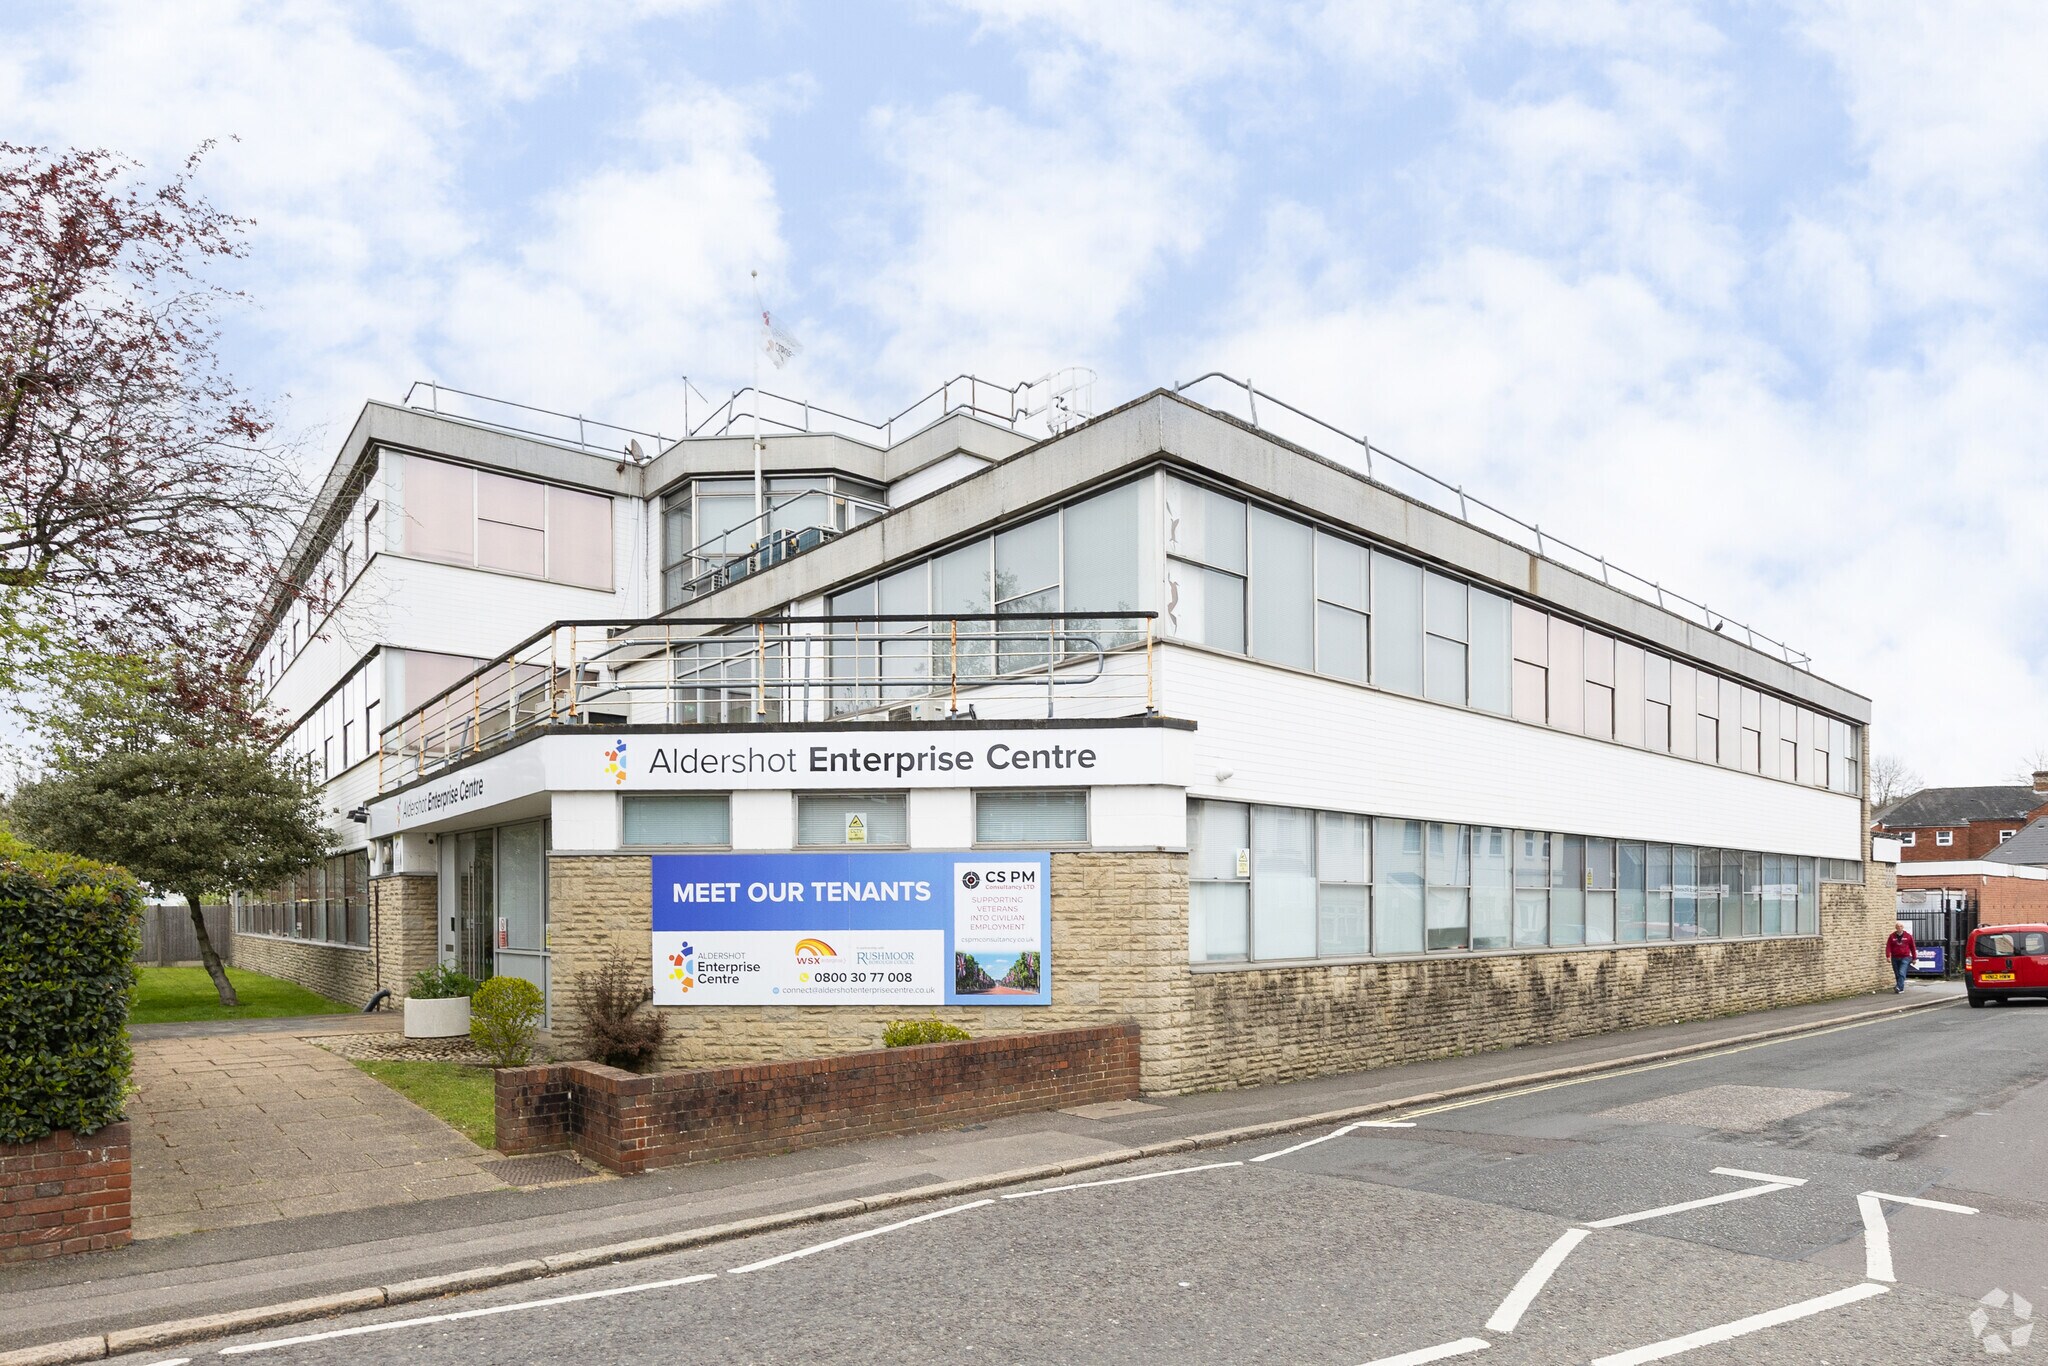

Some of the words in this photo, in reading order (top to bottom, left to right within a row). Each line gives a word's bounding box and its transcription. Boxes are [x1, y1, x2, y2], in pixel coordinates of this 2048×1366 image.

[649, 747, 797, 774] Aldershot
[809, 745, 974, 778] Enterprise
[986, 743, 1097, 770] Centre
[403, 795, 427, 818] Aldershot
[428, 784, 458, 812] Enterprise
[460, 777, 484, 801] Centre
[985, 871, 1006, 883] CS
[1011, 871, 1035, 883] PM
[673, 882, 741, 903] MEET
[747, 882, 805, 903] OUR
[811, 881, 932, 902] TENANTS
[971, 896, 1024, 904] SUPPORTING
[976, 905, 1019, 913] VETERANS
[970, 914, 990, 922] INTO
[970, 923, 1025, 931] EMPLOYMENT
[698, 952, 746, 960] ALDERSHOT
[856, 951, 915, 966] RUSHMOOR
[697, 961, 761, 974] Enterprise
[697, 973, 740, 984] Centre
[814, 972, 847, 983] 0800
[850, 972, 867, 983] 30
[870, 972, 885, 983] 77
[887, 972, 913, 983] 008
[782, 986, 936, 995] connect@aldershotenterprisecentre.co.uk
